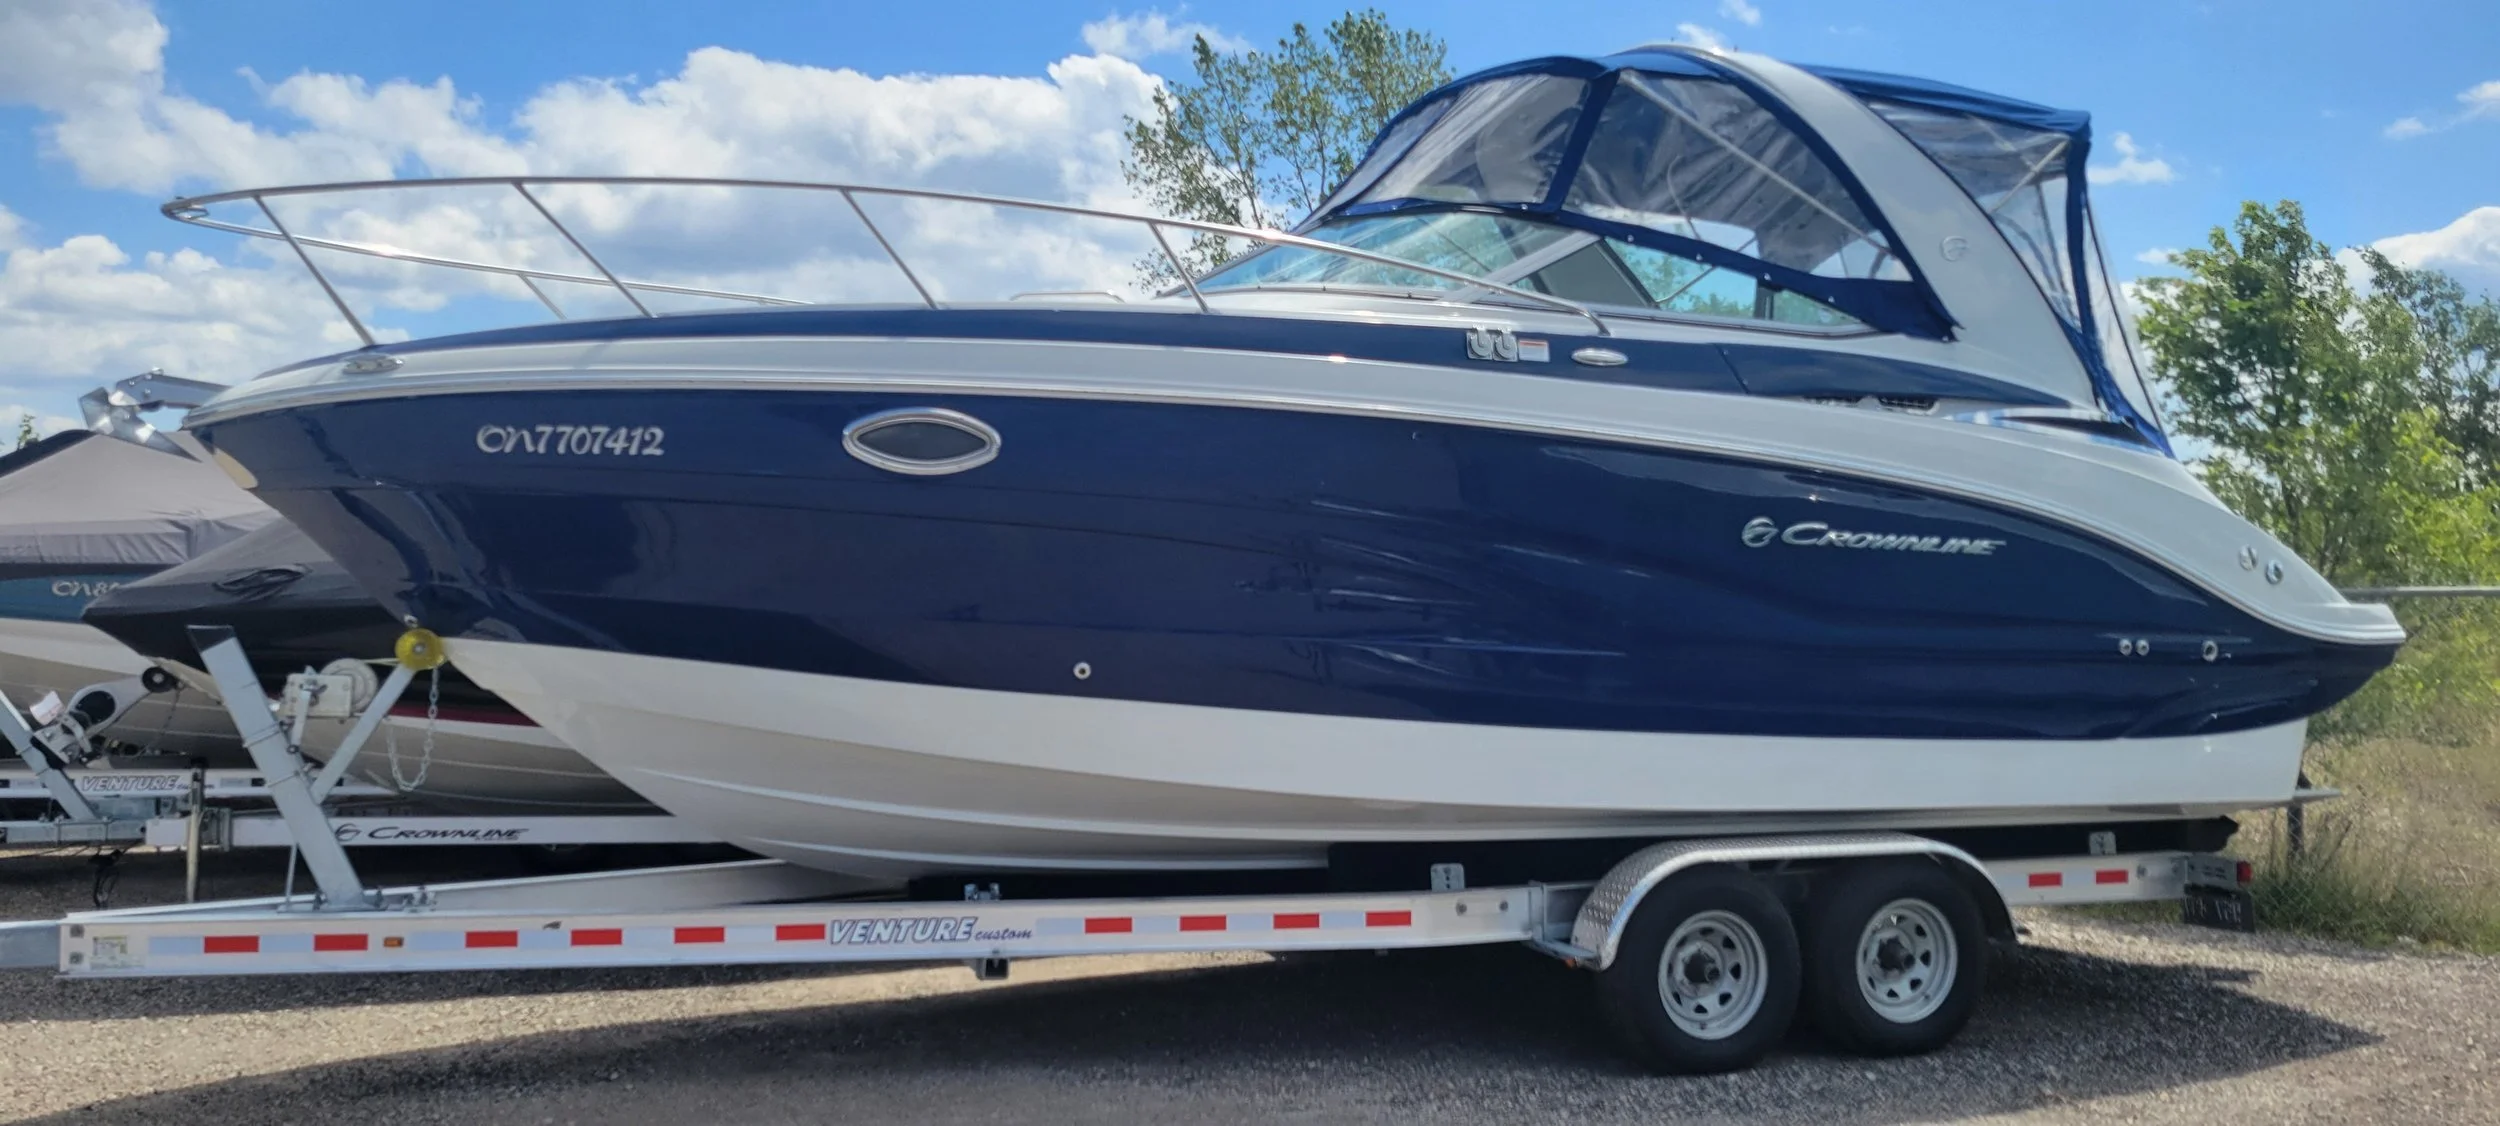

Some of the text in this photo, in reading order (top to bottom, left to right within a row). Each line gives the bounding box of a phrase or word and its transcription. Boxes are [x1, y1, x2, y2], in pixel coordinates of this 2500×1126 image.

[476, 424, 665, 456] ON7707412
[1781, 521, 2007, 555] CROWNLINE
[82, 775, 180, 791] VENTURE
[368, 826, 529, 839] CROWNLINE
[830, 916, 1032, 945] VENTURE custom
